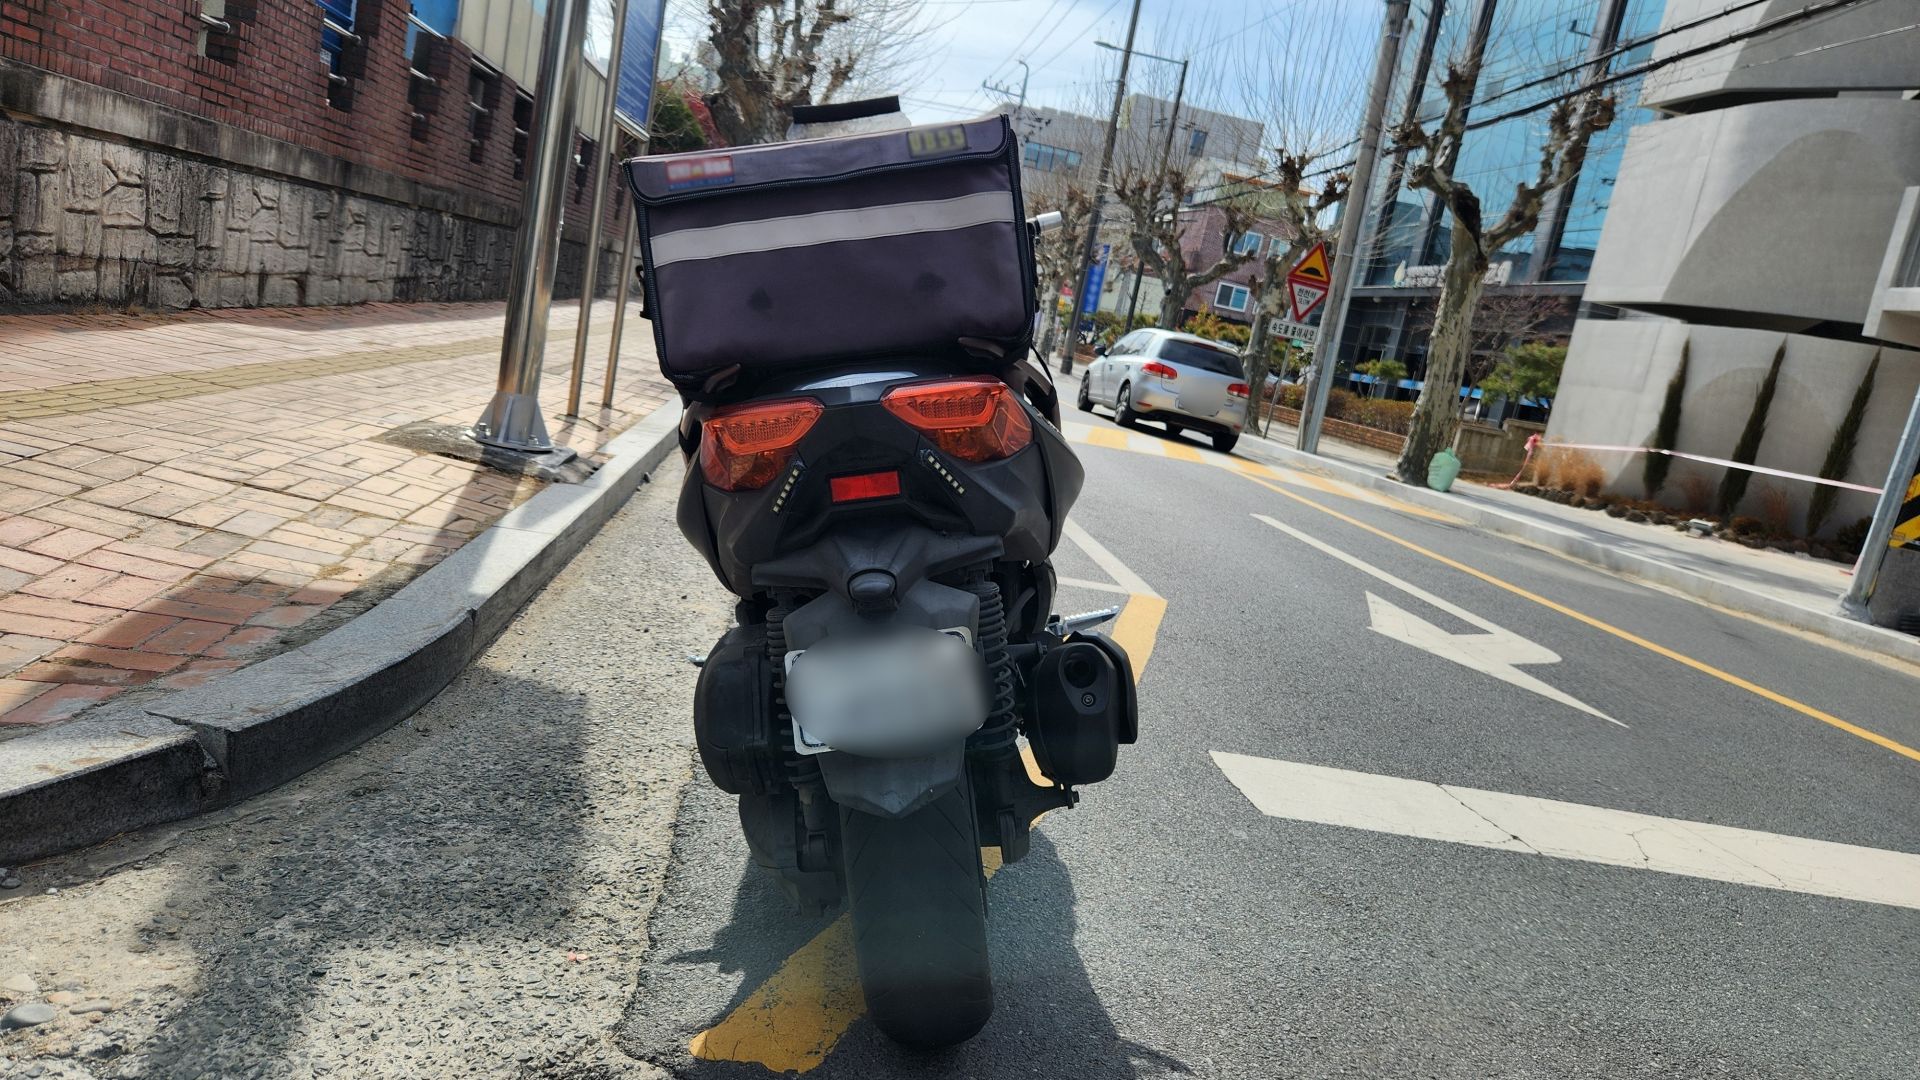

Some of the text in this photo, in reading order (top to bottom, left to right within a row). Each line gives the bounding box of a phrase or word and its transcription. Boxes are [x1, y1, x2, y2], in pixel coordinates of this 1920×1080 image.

[1297, 288, 1317, 299] 천천히
[1271, 322, 1315, 341] 속도를 줄이시오
